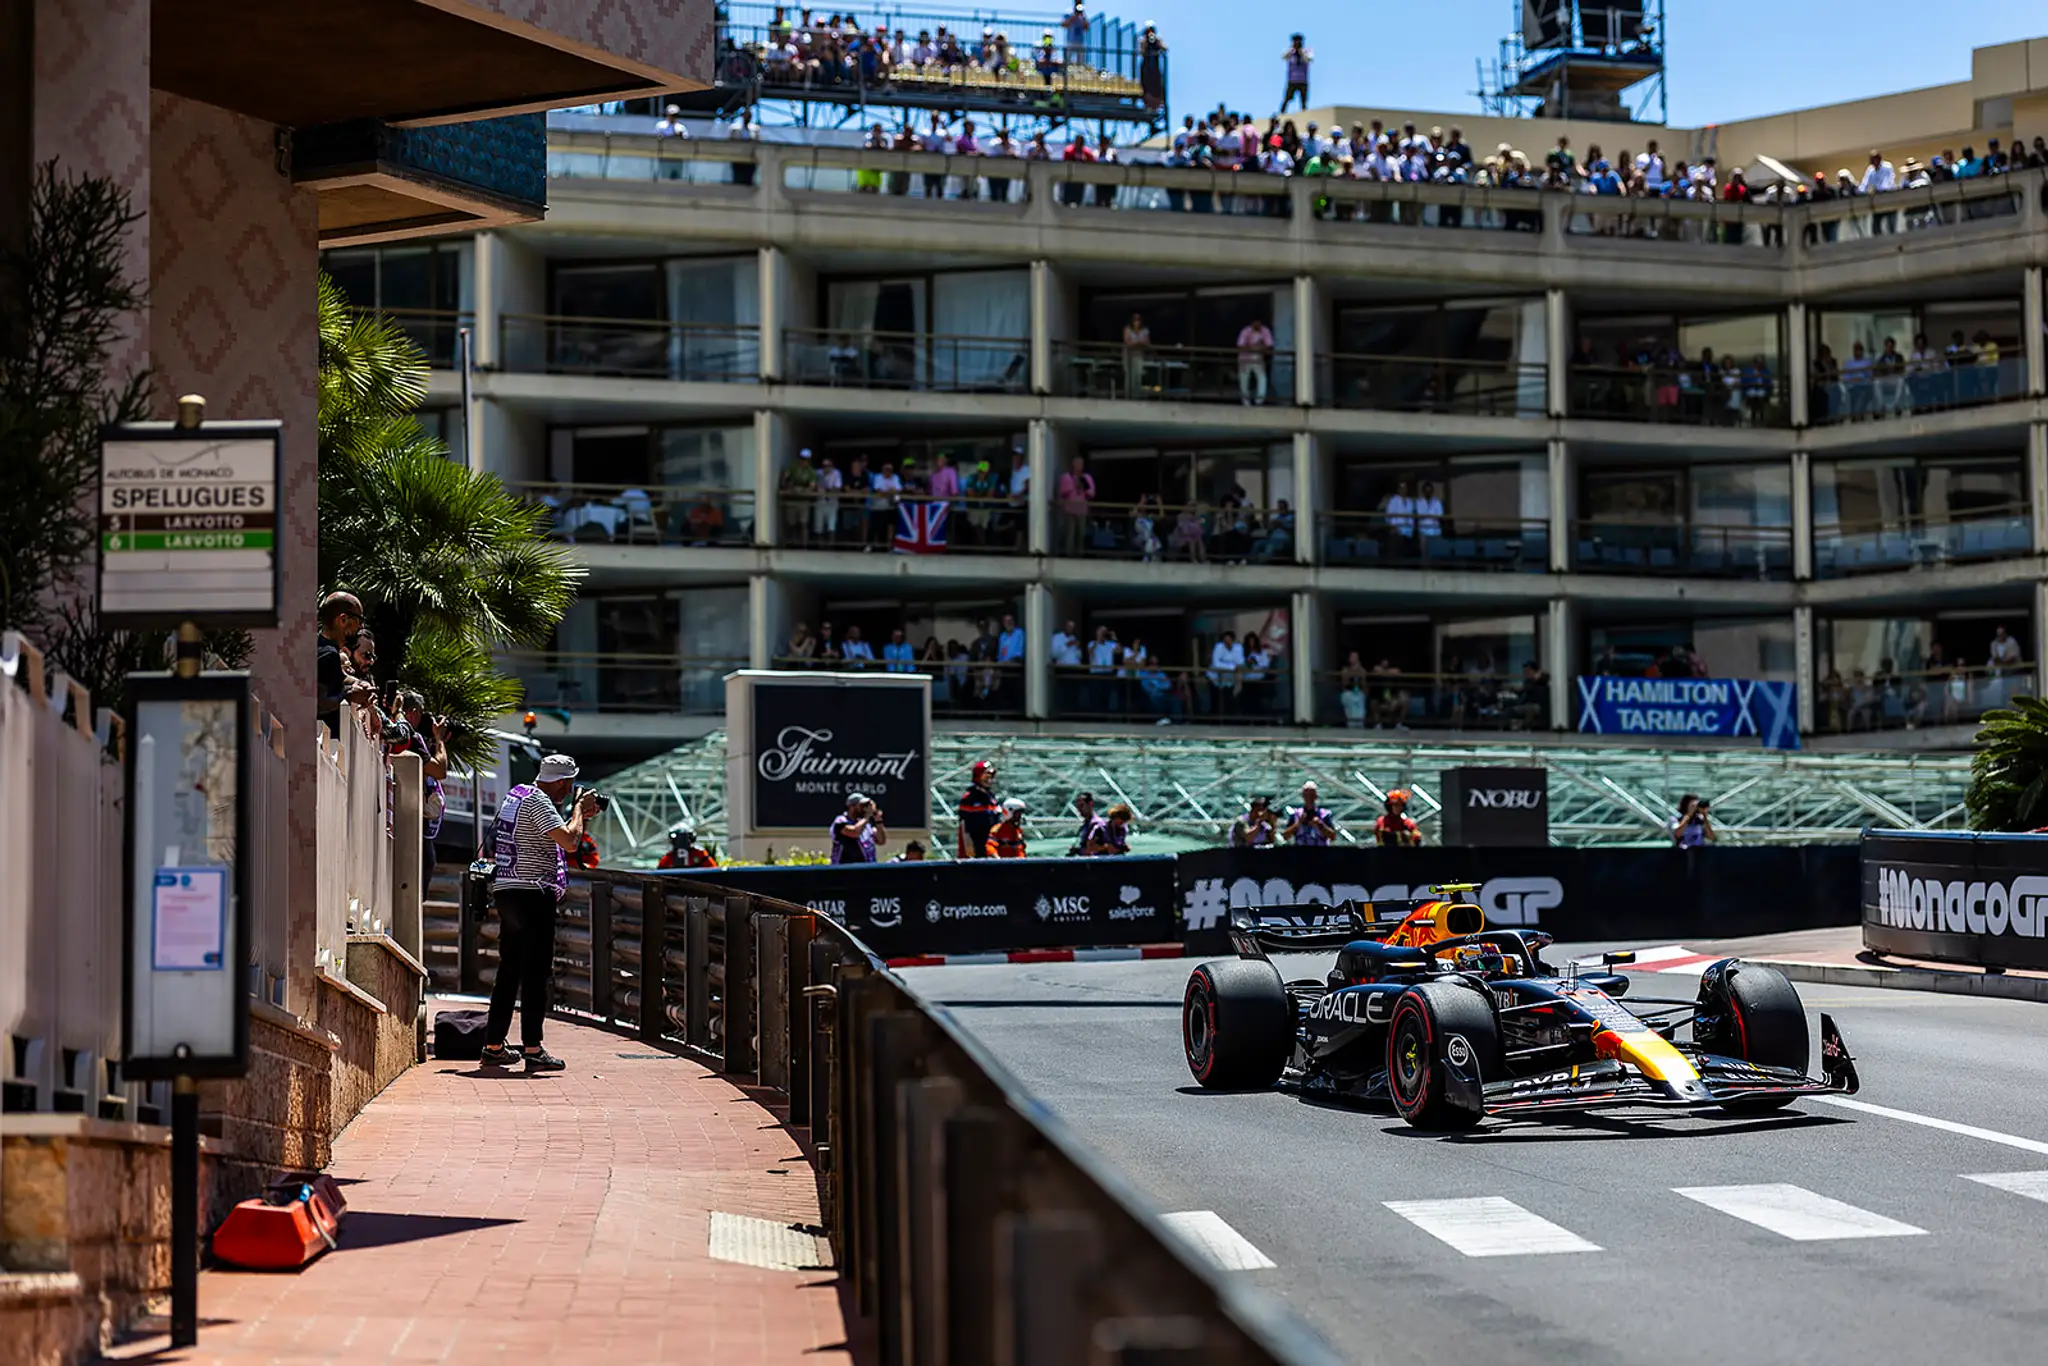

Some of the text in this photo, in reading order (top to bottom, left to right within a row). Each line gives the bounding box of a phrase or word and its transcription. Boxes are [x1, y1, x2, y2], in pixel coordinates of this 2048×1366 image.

[160, 468, 174, 479] DE
[179, 466, 234, 479] MONACO
[112, 486, 265, 509] SPELUGUES
[164, 515, 245, 529] LARVOTTO
[109, 533, 245, 551] 6 LARVOTTO
[1606, 680, 1728, 705] HAMILTON
[1617, 708, 1720, 732] TARMAC
[758, 725, 920, 781] Fairmont
[795, 781, 887, 794] MONTE CARLO
[1468, 788, 1542, 809] NOBU
[943, 904, 1008, 920] crypto.com
[1052, 896, 1091, 914] MSC
[1182, 877, 1563, 930] #MoGP
[1310, 992, 1392, 1023] ORACLE
[1451, 1044, 1467, 1057] Esso
